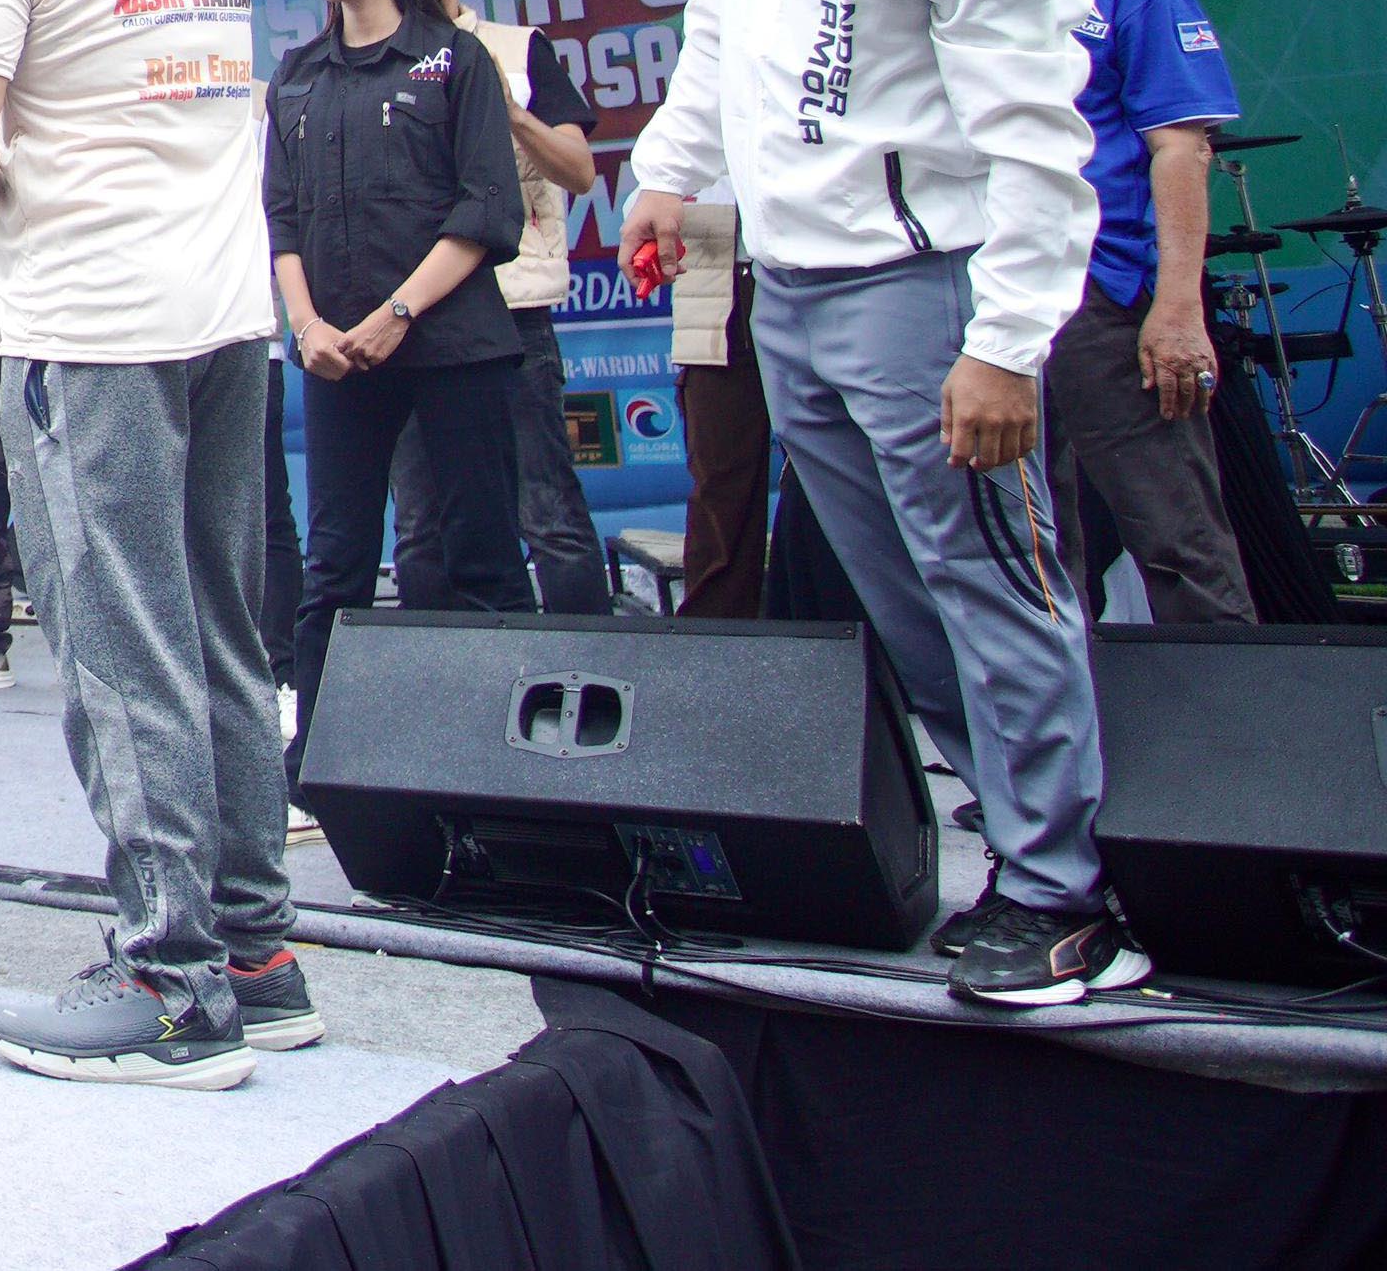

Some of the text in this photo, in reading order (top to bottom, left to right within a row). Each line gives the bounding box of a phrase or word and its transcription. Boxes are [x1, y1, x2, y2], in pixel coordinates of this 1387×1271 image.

[122, 16, 153, 29] CALON
[154, 13, 194, 25] GUBERNUR
[144, 54, 250, 86] Riau Emas
[195, 86, 225, 100] Rakyat
